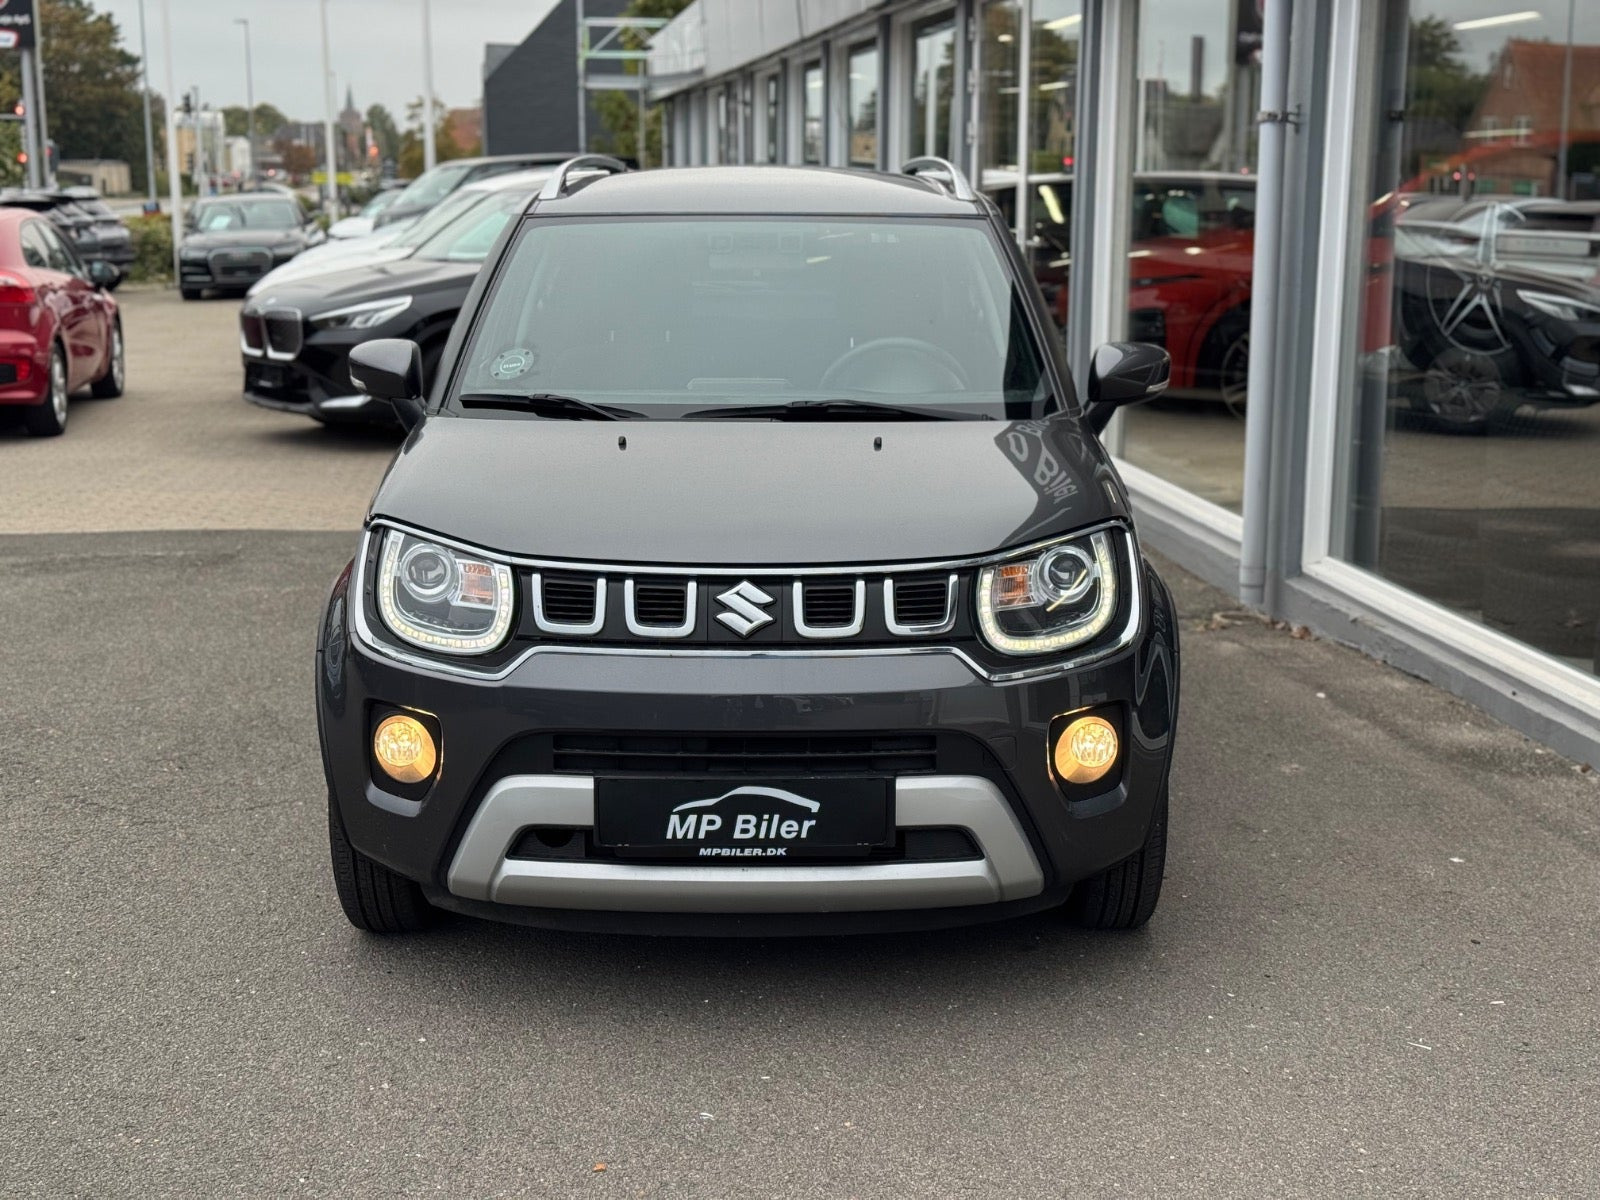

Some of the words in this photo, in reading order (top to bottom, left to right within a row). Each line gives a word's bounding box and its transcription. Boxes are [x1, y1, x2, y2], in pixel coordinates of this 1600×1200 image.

[665, 814, 723, 840] MP
[732, 814, 817, 840] Biler
[699, 847, 787, 857] MPBILER.DK
